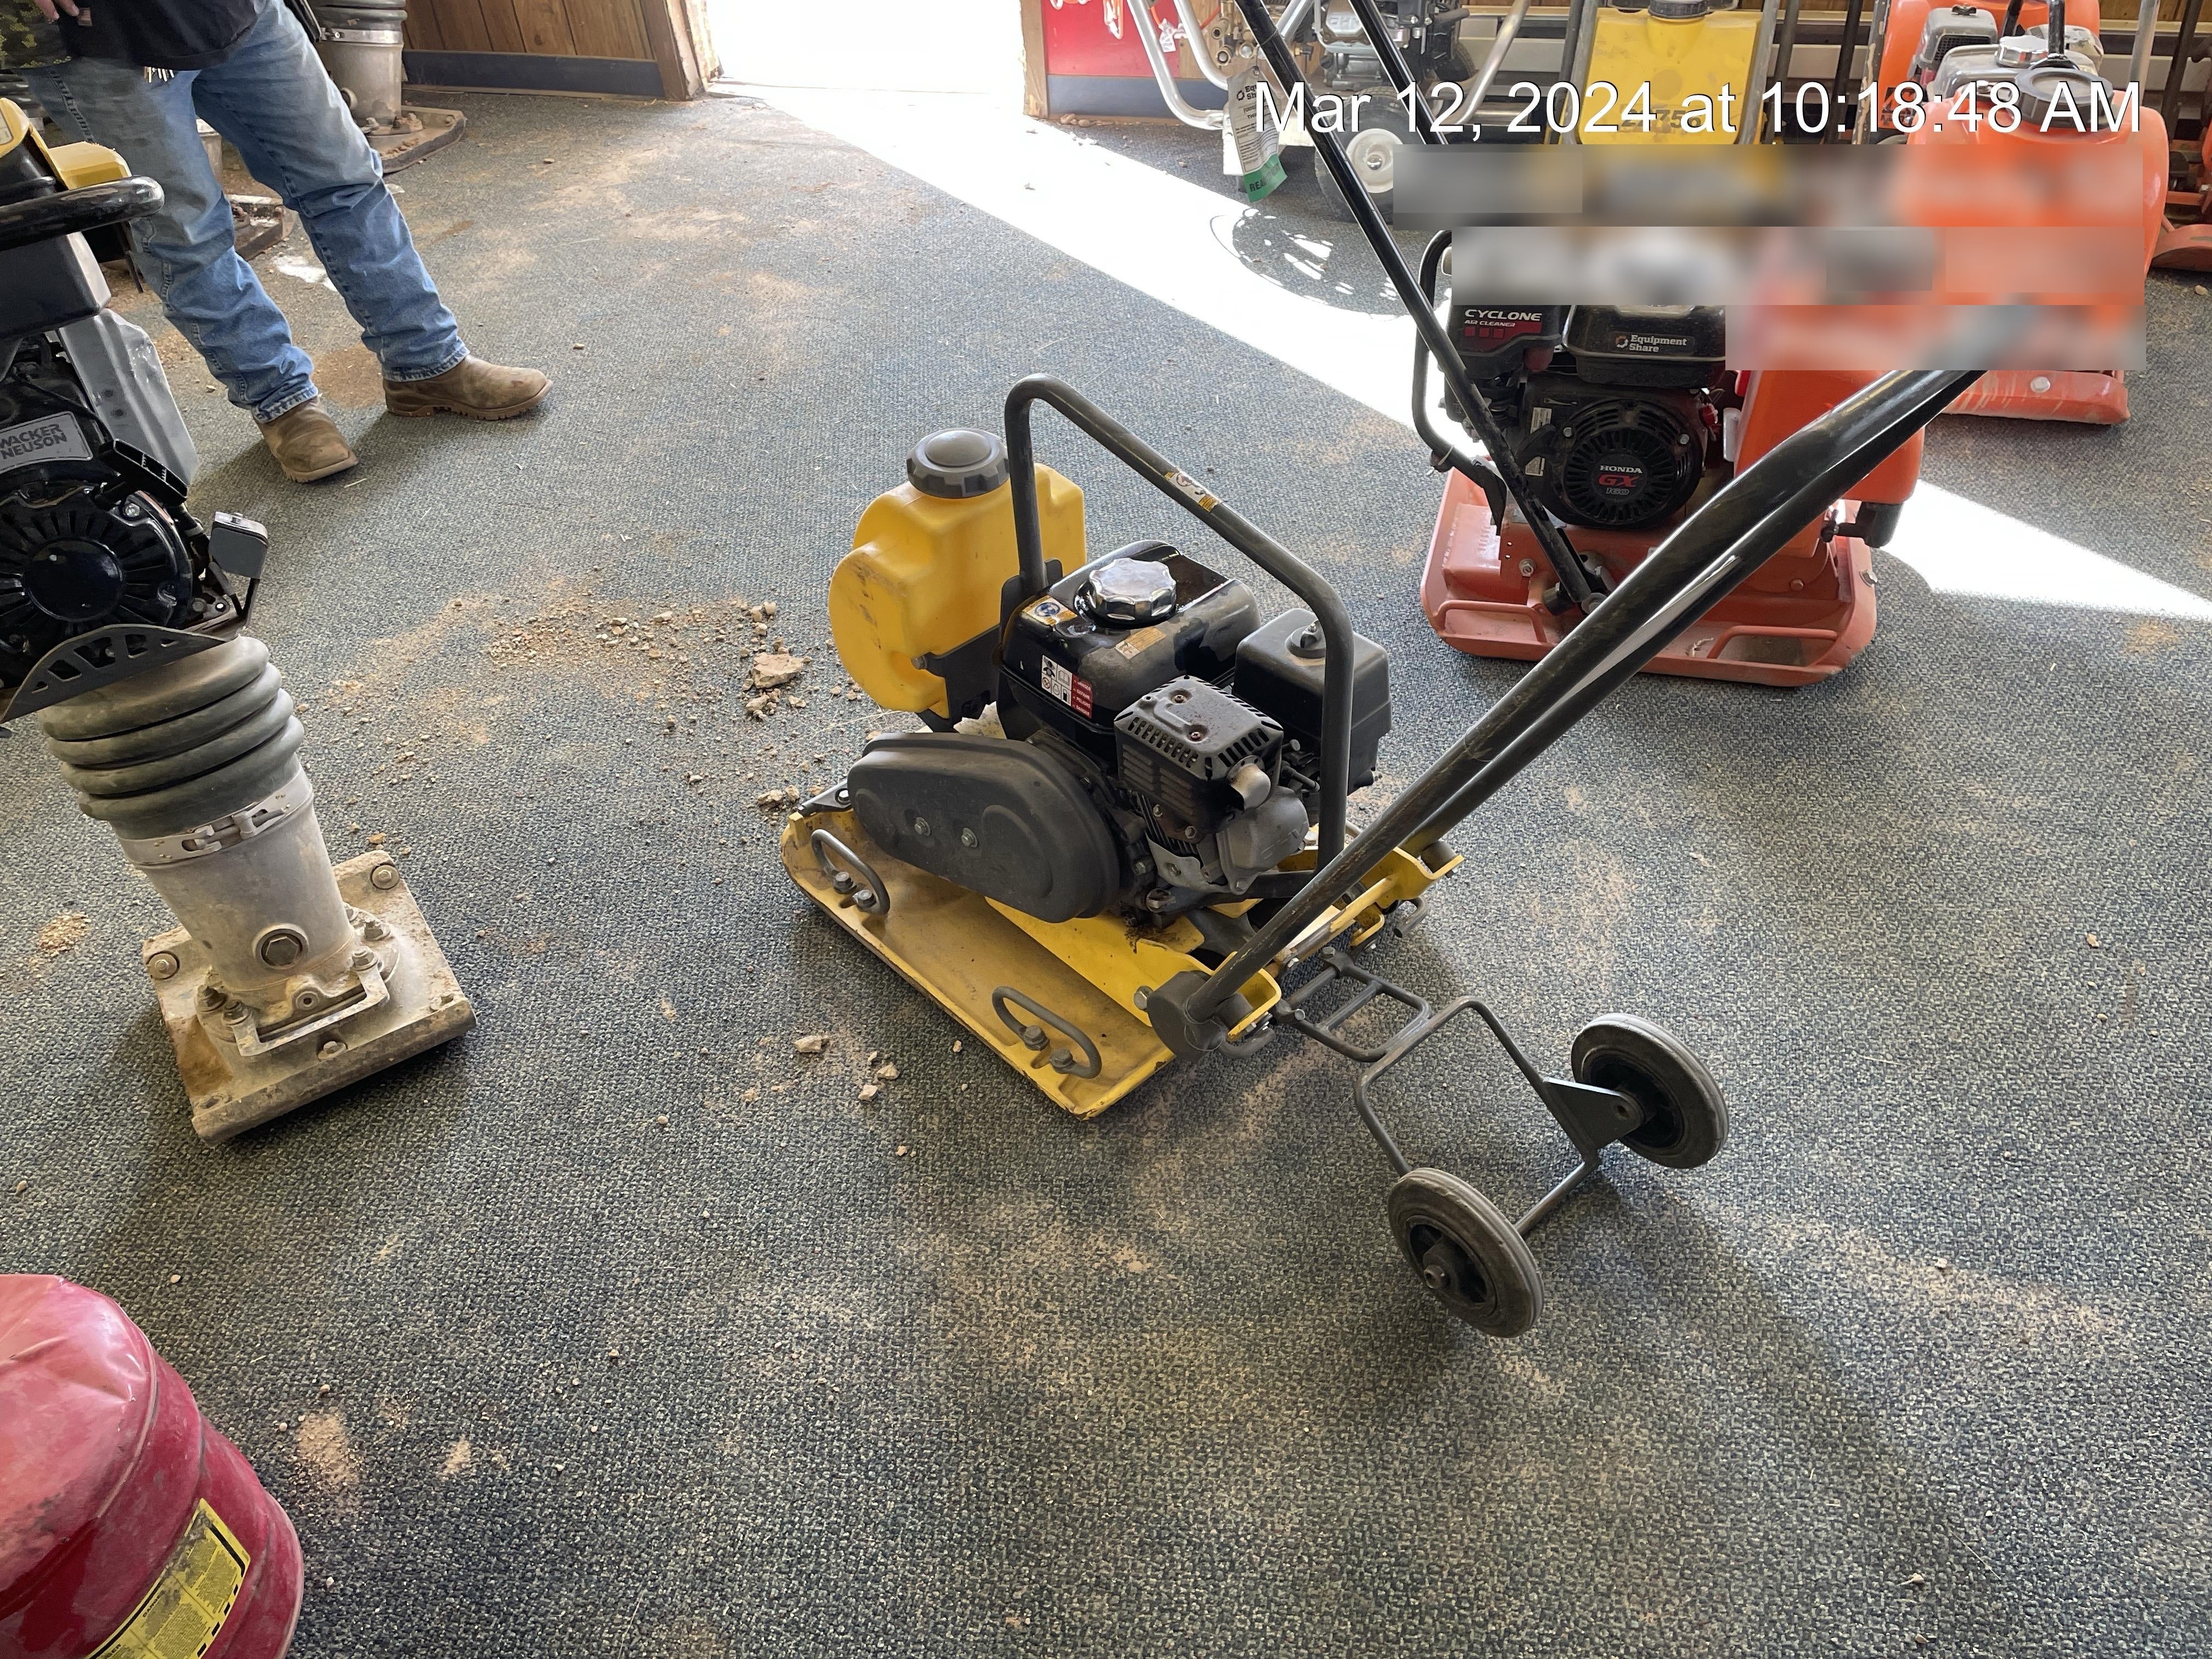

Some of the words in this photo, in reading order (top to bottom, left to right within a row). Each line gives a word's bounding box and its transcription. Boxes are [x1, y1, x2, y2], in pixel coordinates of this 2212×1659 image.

[1465, 309, 1542, 321] CYCLONE
[1630, 334, 1688, 346] Equipment
[1629, 343, 1660, 352] Share
[0, 424, 63, 449] WACKER
[0, 432, 67, 459] NEUSON
[1600, 465, 1643, 473] HONDA
[1599, 474, 1640, 487] GX
[1606, 487, 1630, 495] 160
